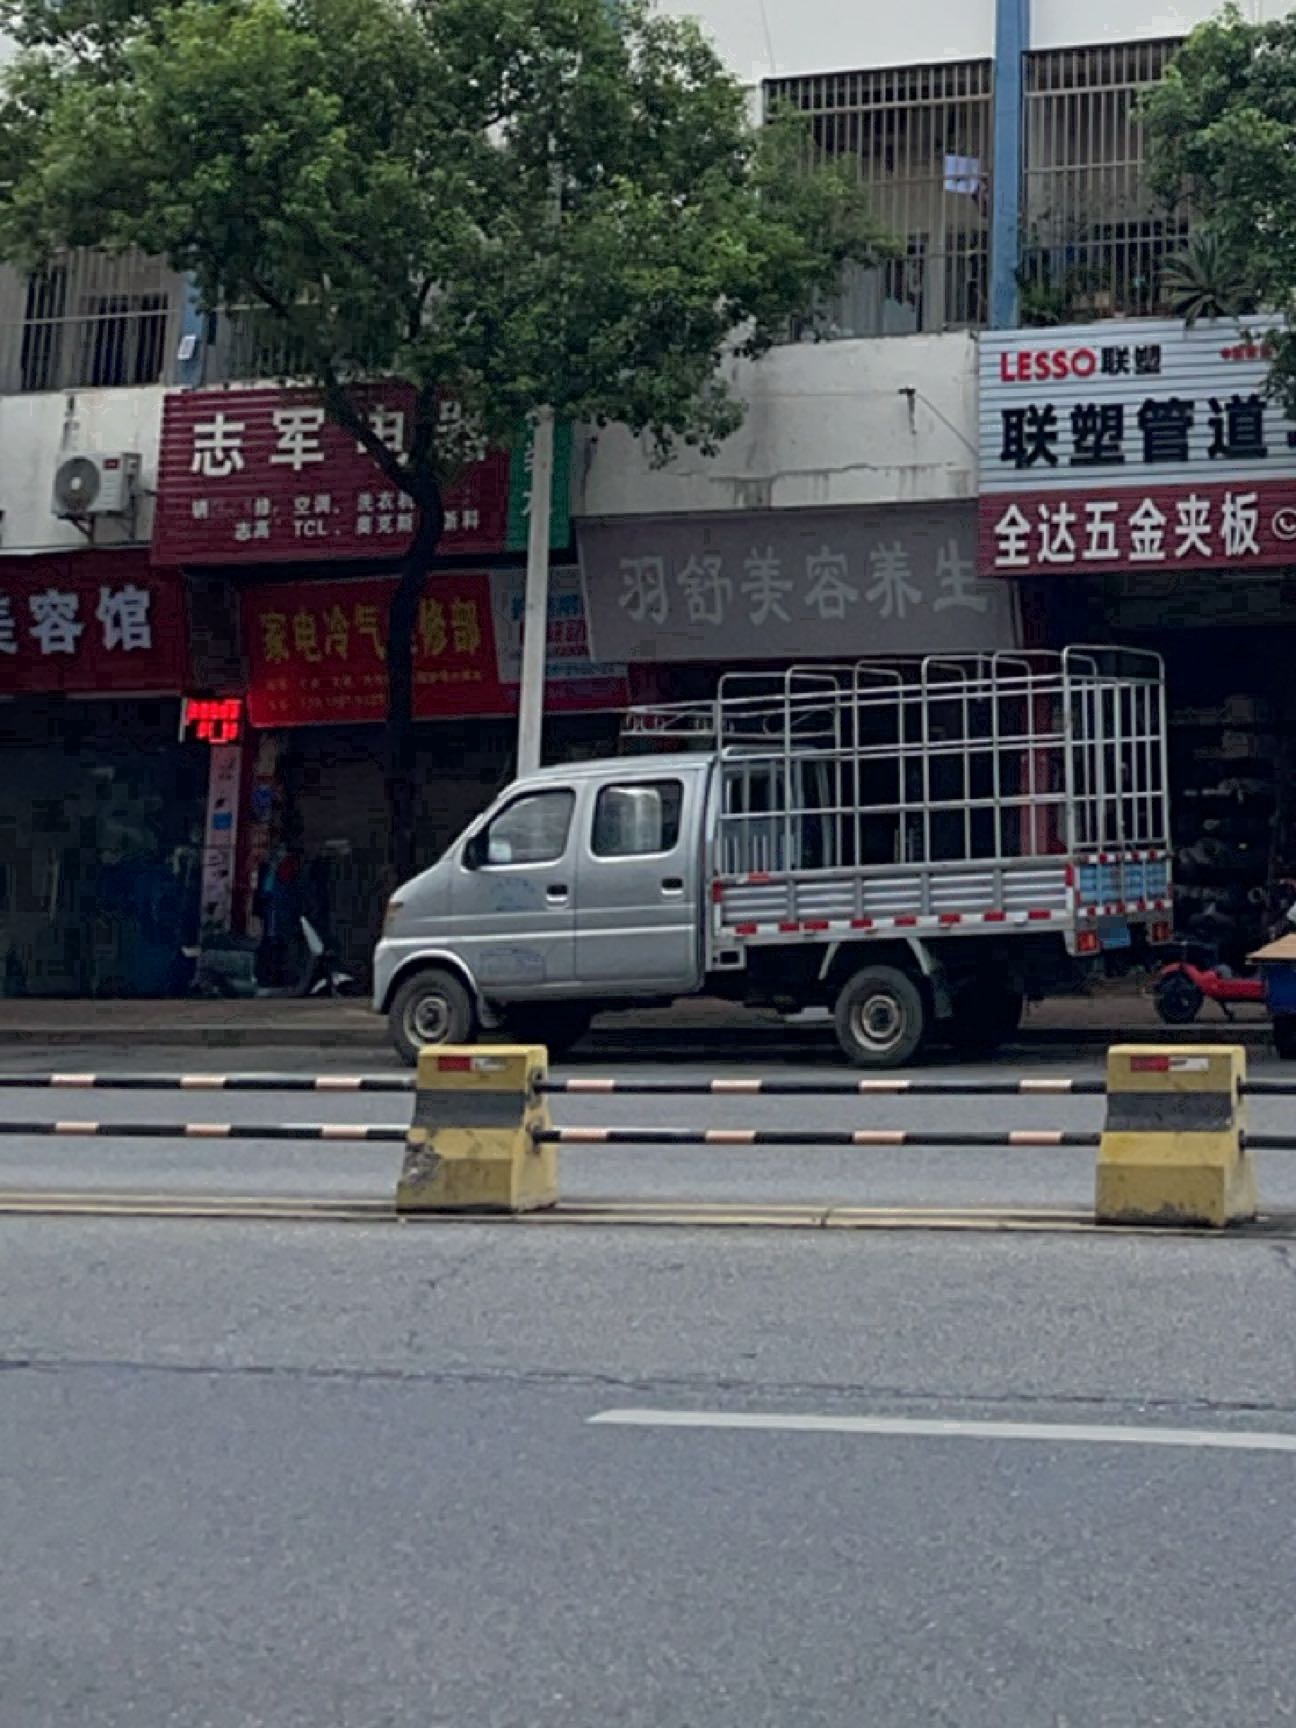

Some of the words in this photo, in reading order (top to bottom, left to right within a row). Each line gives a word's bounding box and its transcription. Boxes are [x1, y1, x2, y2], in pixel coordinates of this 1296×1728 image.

[1000, 347, 1097, 382] LESSO
[1101, 344, 1161, 375] 联塑
[1000, 393, 1268, 469] 联塑管道
[994, 490, 1261, 569] 全达五金夹板
[617, 538, 988, 627] 羽舒美容养生
[259, 596, 483, 665] 家电冷气修部
